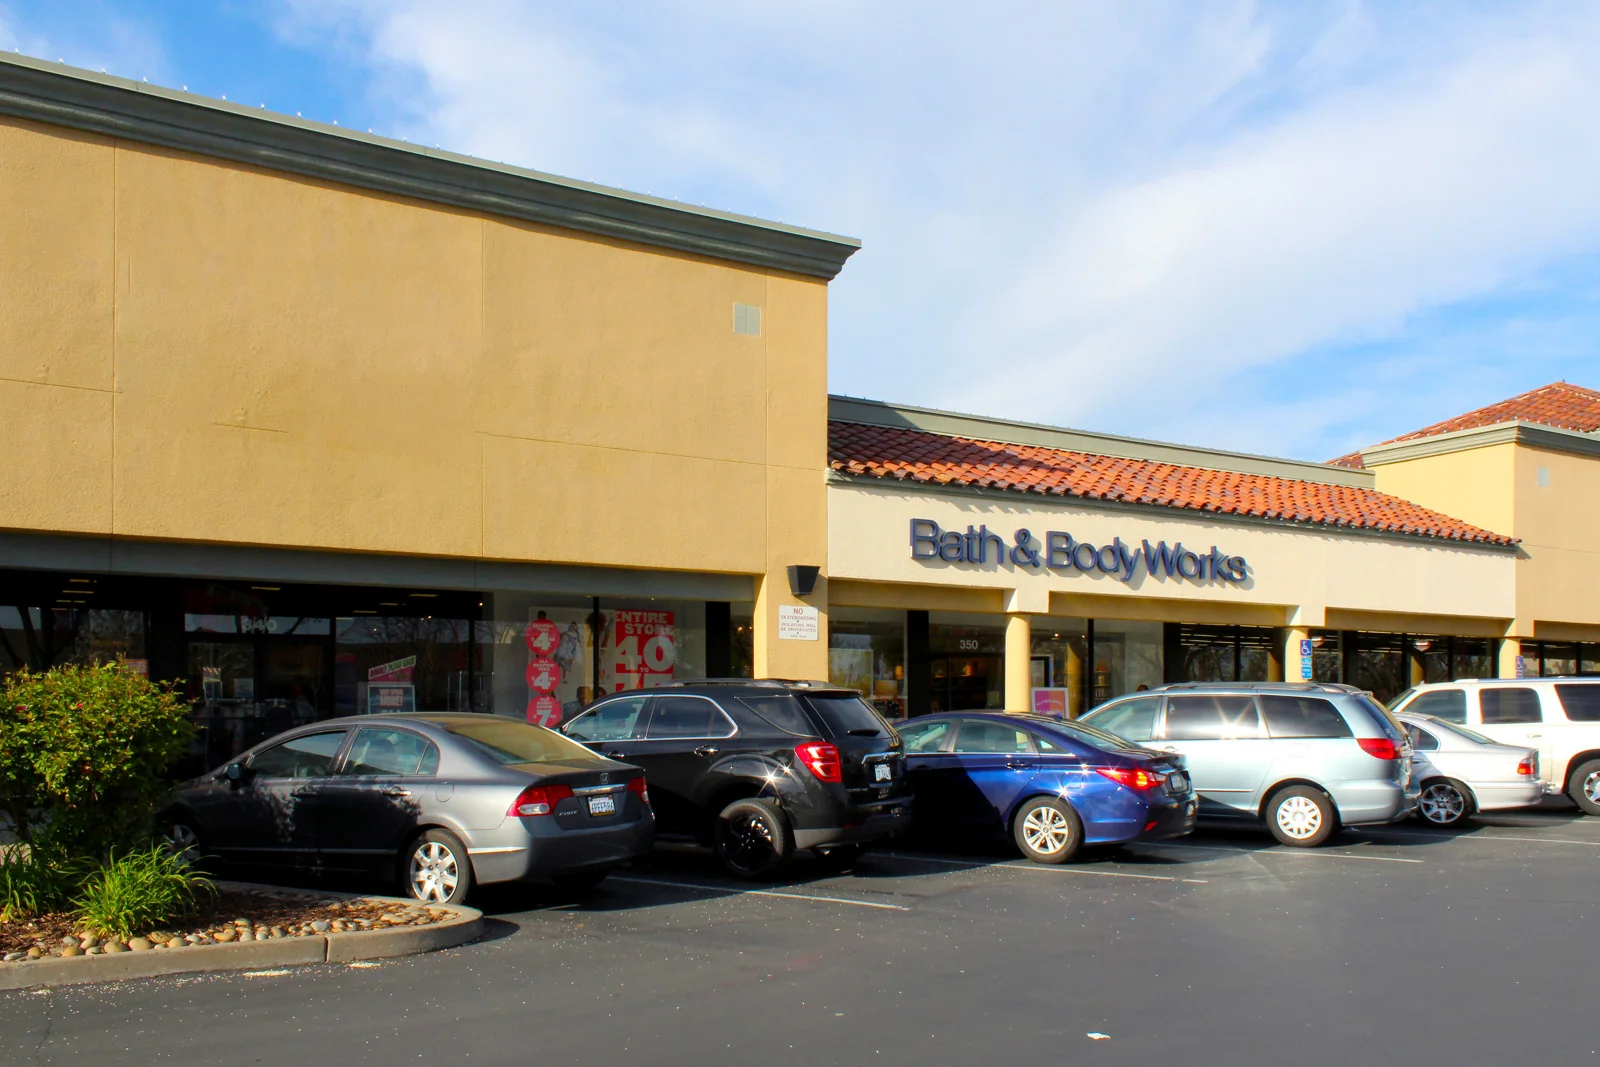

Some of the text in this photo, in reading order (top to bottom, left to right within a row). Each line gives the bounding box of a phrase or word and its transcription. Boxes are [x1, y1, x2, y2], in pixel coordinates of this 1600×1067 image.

[910, 518, 1248, 582] Bath & Body Works
[615, 611, 668, 623] ENTIRE
[625, 623, 674, 636] STORE
[960, 640, 978, 650] 350
[613, 636, 677, 672] 40
